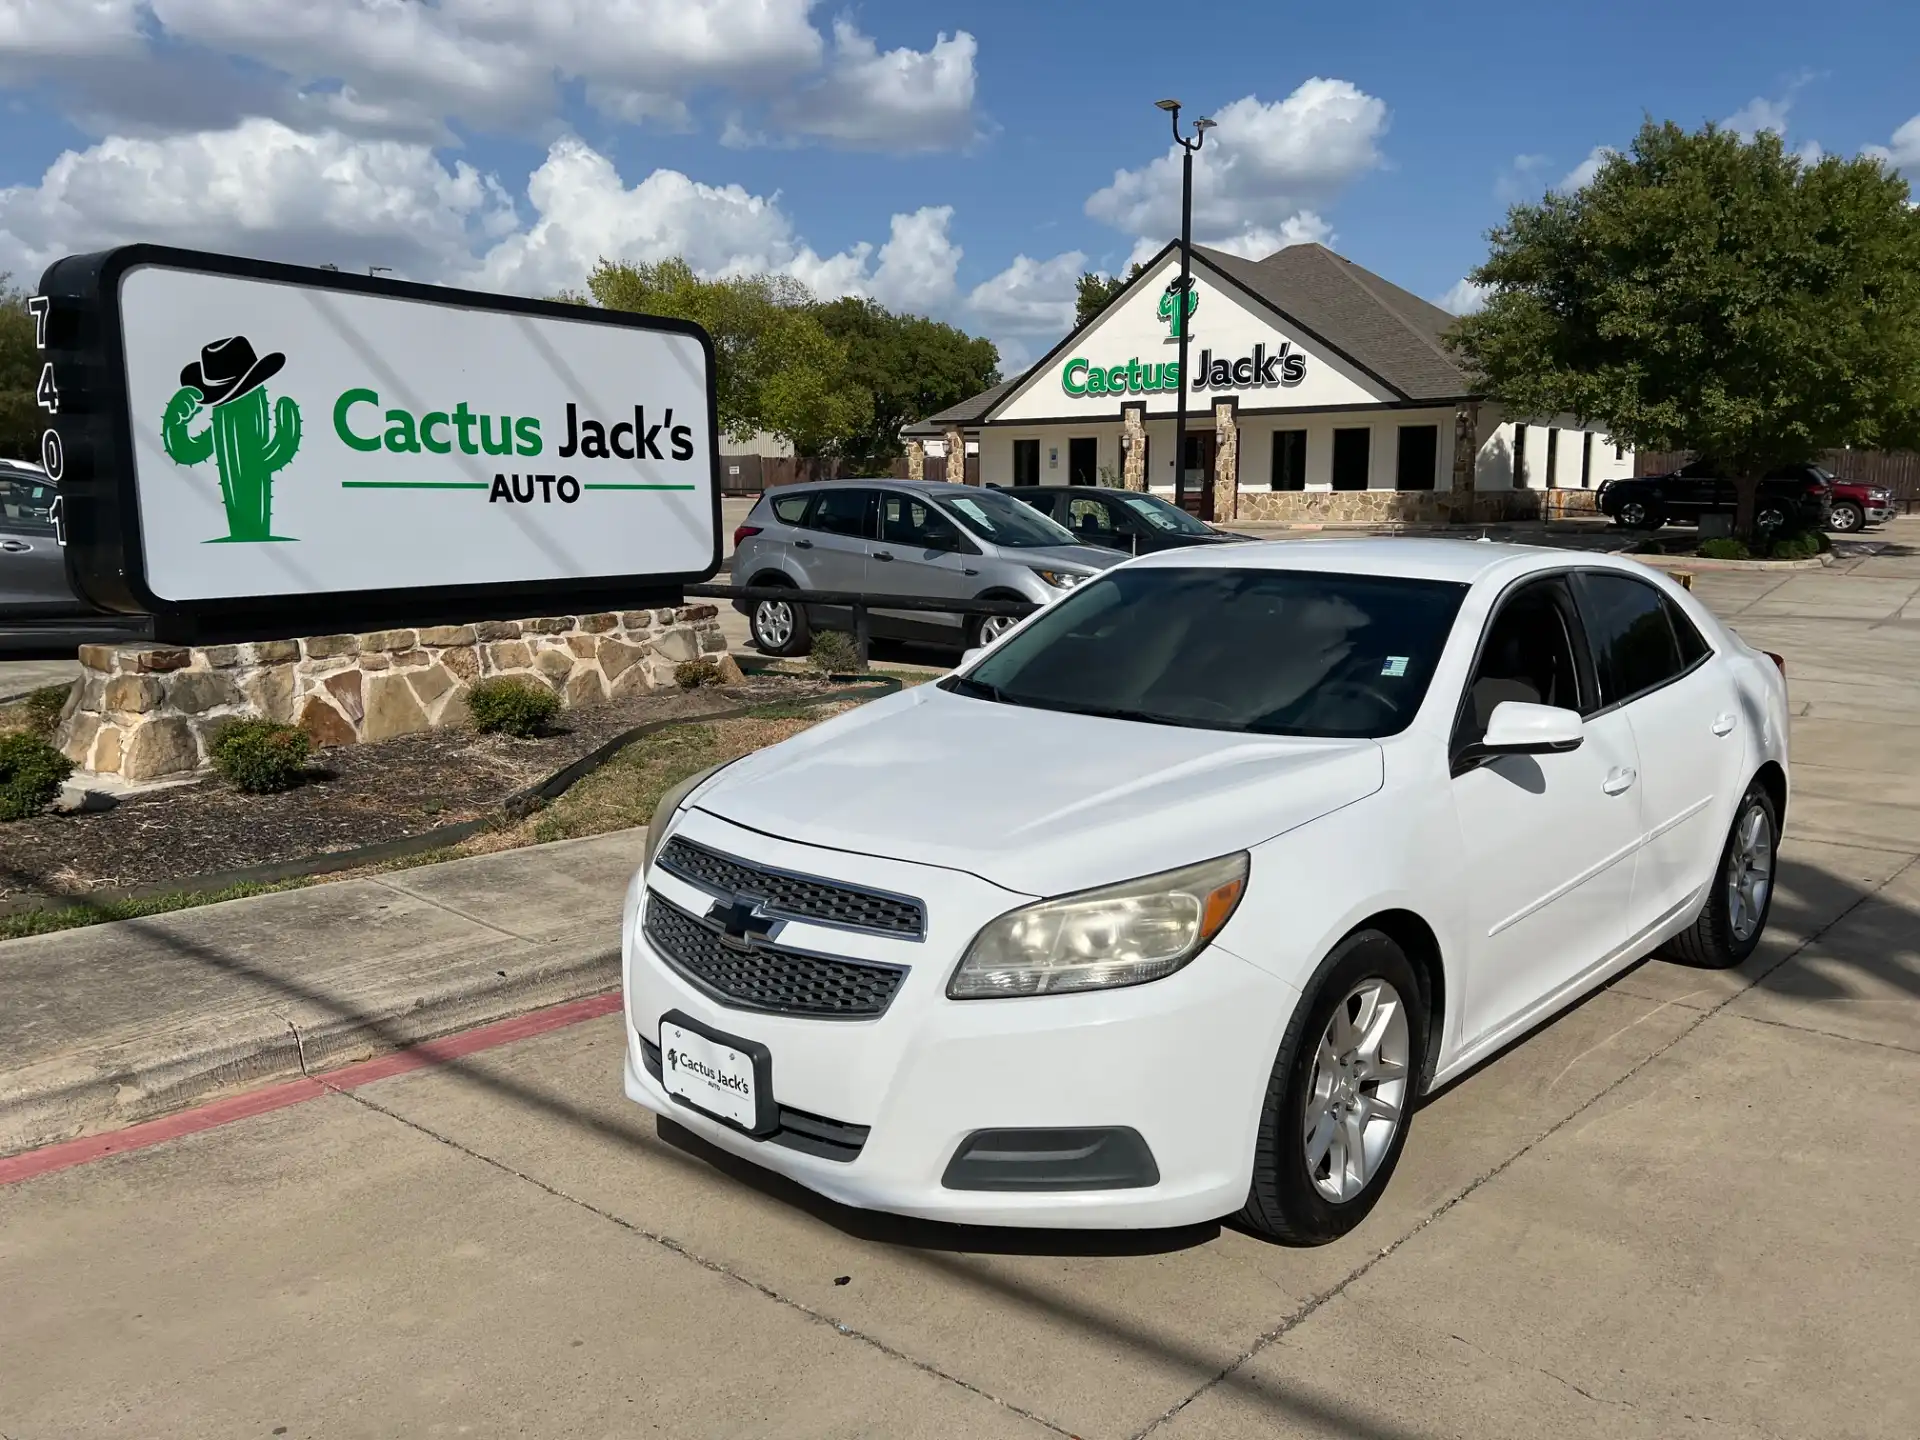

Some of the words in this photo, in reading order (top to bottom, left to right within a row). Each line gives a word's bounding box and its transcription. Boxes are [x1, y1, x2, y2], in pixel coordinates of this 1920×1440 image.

[1062, 357, 1180, 395] Cactus
[1193, 341, 1306, 388] Jack's
[27, 296, 67, 546] 7401
[333, 388, 543, 456] Cactus
[558, 403, 694, 461] Jack's
[489, 473, 581, 504] AUTO
[680, 1053, 715, 1080] Cactus
[717, 1070, 749, 1094] Jack's
[707, 1081, 721, 1092] AUTO
